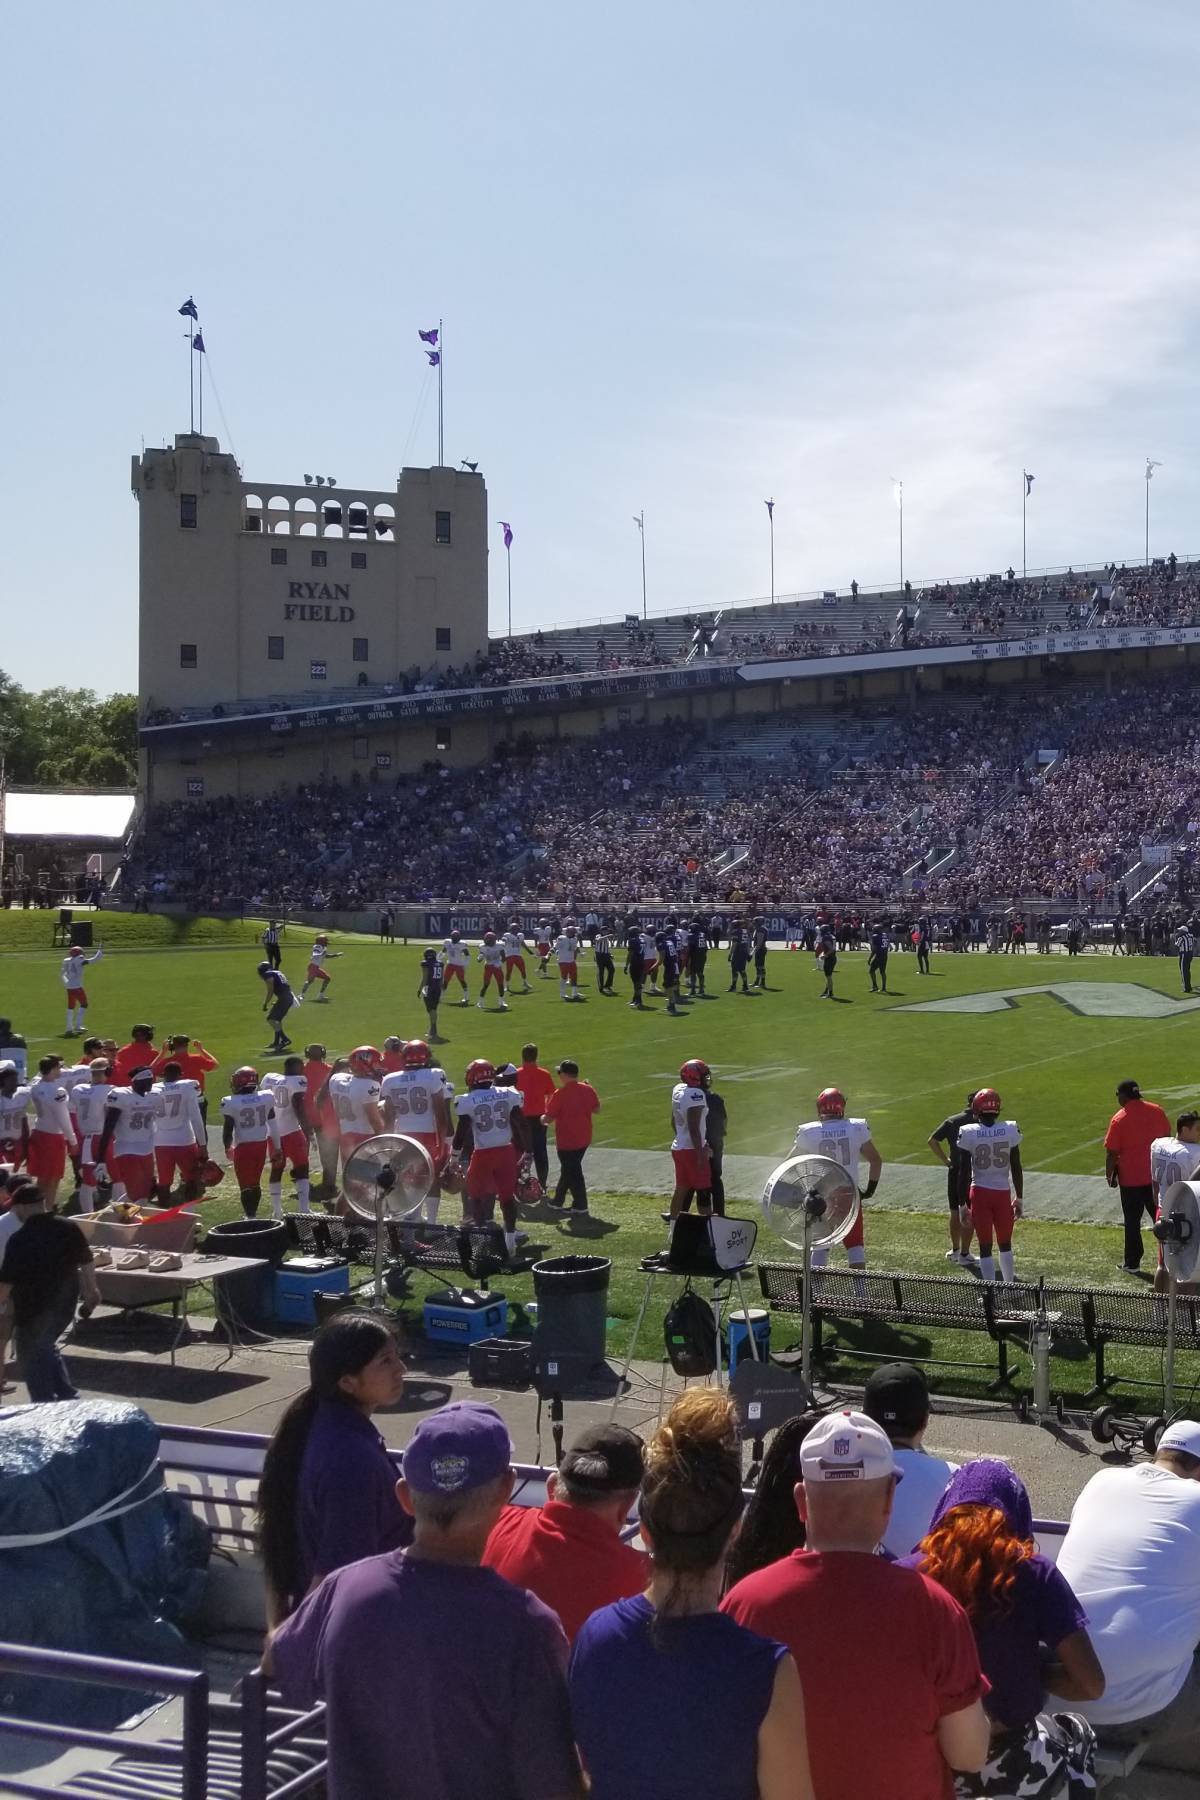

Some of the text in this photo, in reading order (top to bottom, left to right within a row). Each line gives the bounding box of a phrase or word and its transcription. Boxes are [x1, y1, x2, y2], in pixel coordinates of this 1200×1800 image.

[287, 581, 351, 600] RYAN
[284, 603, 356, 622] FIELD
[240, 1104, 267, 1129] 31
[474, 1100, 510, 1132] 33
[976, 1128, 1006, 1138] BALLARD
[975, 1141, 1010, 1170] 85
[1153, 1158, 1182, 1187] 70
[731, 1229, 743, 1240] DV
[432, 1319, 469, 1331] POWERADE
